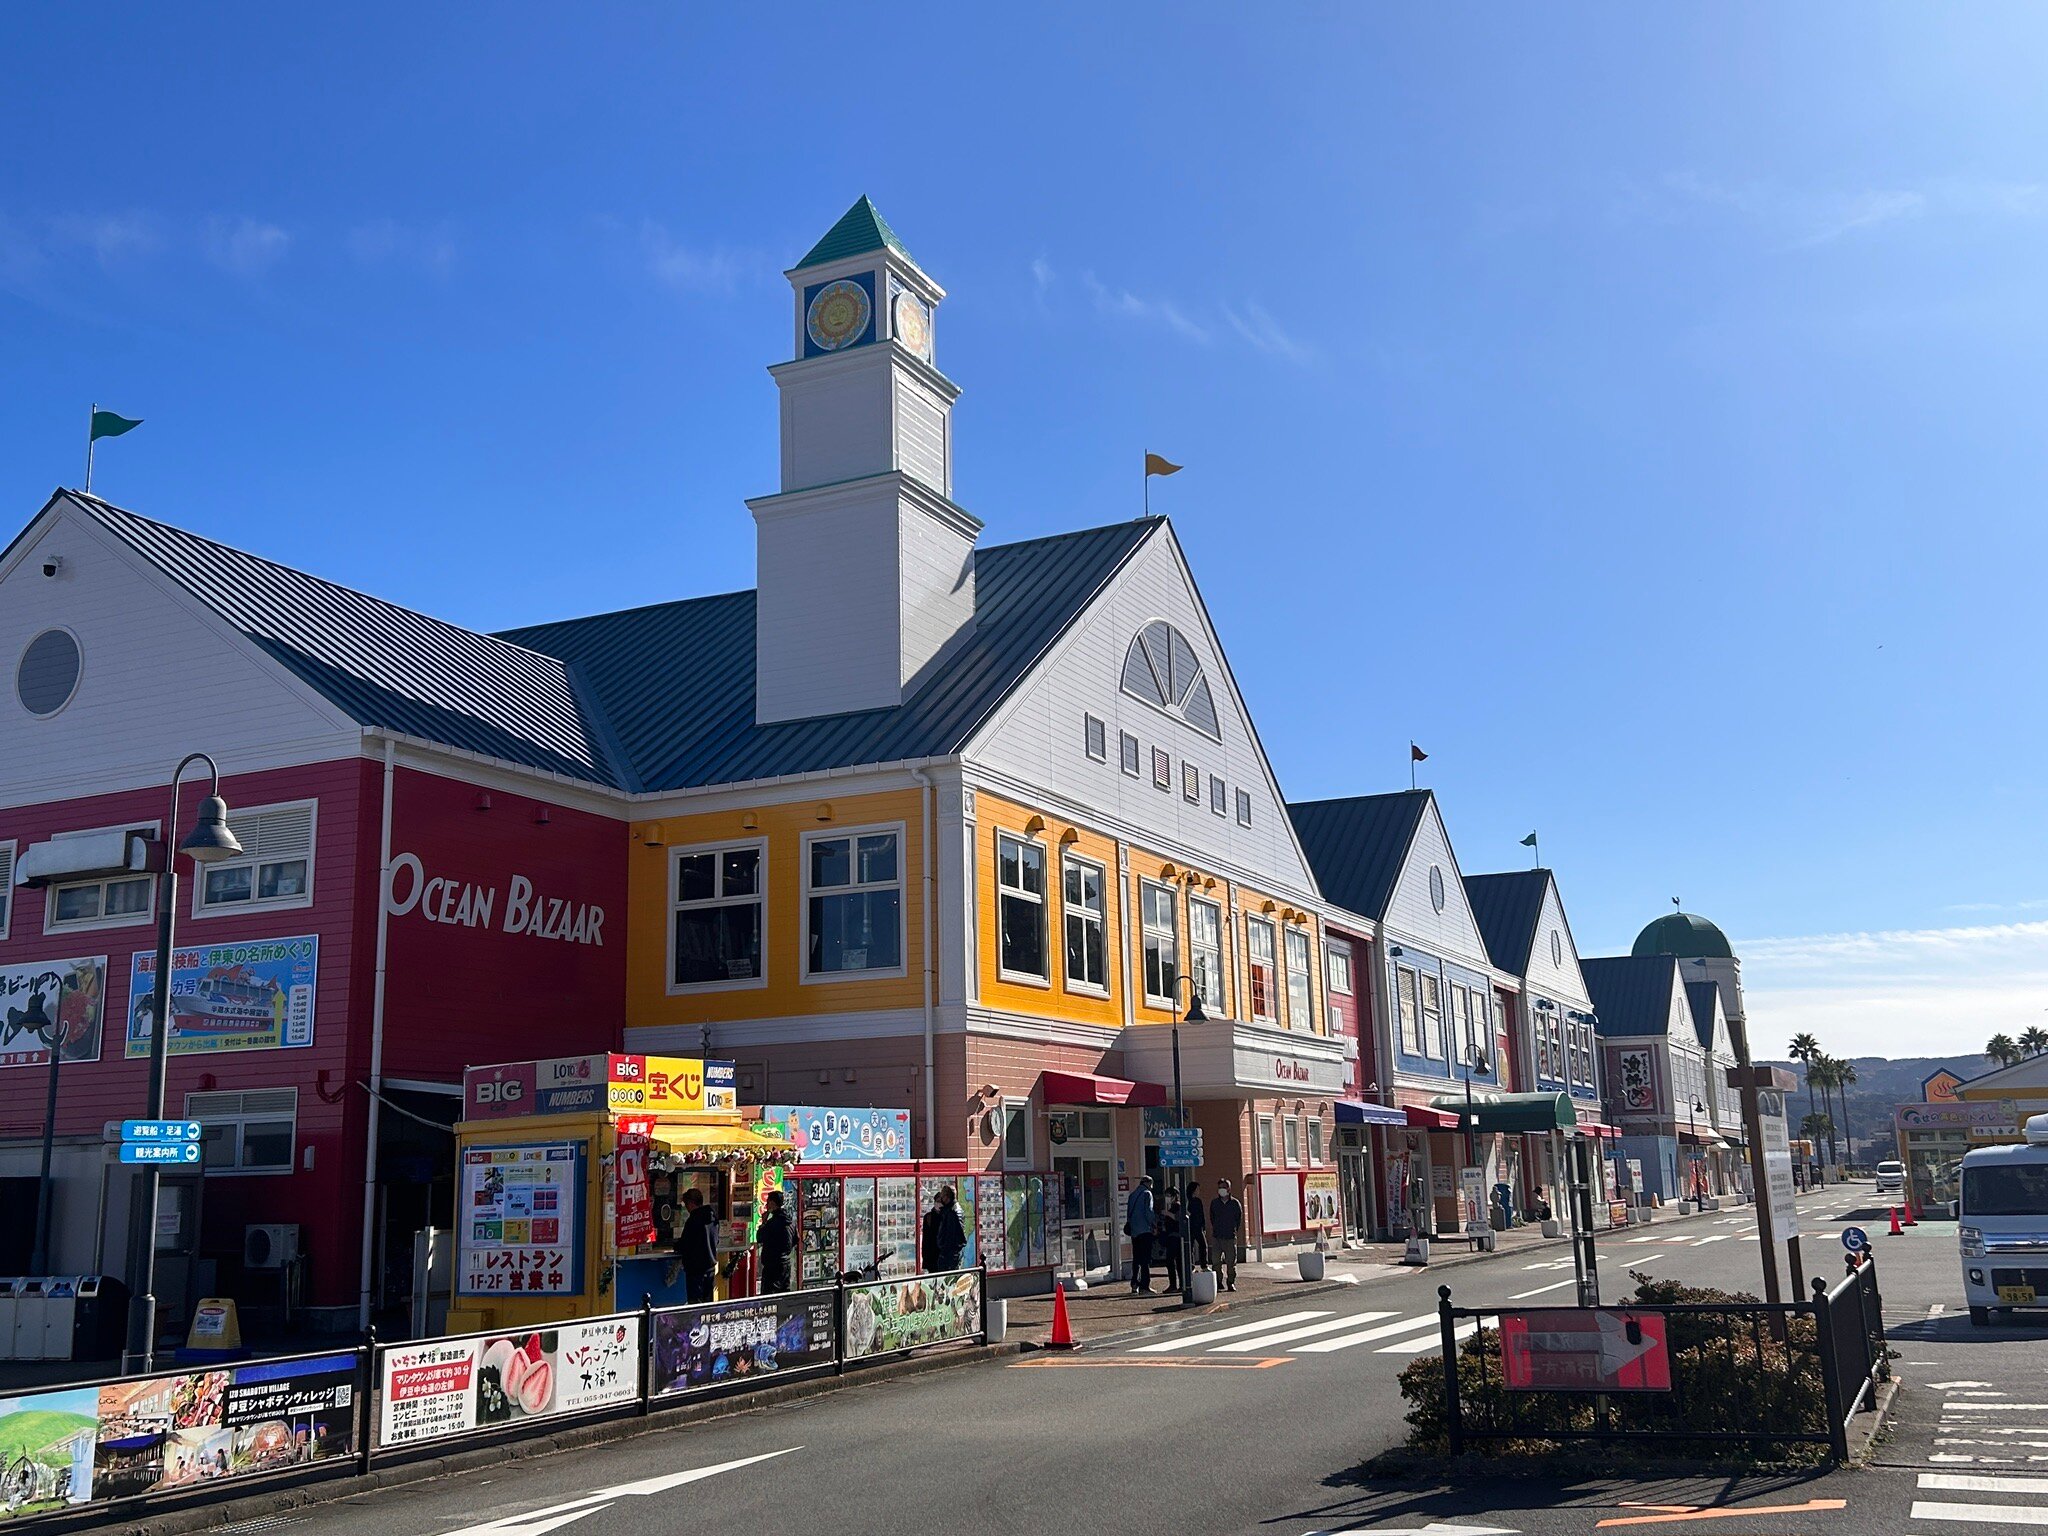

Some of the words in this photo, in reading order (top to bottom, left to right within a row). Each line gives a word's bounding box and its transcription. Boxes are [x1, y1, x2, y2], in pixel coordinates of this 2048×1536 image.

[503, 874, 605, 946] BAZAAR
[137, 941, 312, 972] 海底検船と伊東の名所めぐり
[554, 1064, 576, 1079] LOTO
[616, 1062, 640, 1077] BIG
[706, 1066, 734, 1080] NUMBERS
[476, 1080, 522, 1104] BIG
[648, 1072, 701, 1100] 宝くじ
[548, 1088, 594, 1107] NUMBERS
[133, 1125, 182, 1136] 遊覧船・足湯
[135, 1147, 179, 1158] 観光案内所
[812, 1182, 830, 1198] 360
[486, 1250, 564, 1269] レストラン
[509, 1269, 563, 1291] 営業中
[581, 1325, 615, 1338] 伊豆中央道
[229, 1389, 239, 1399] IZU
[269, 1382, 290, 1394] VILLAGE
[228, 1387, 335, 1414] 伊豆シャボテンヴィレッジ
[566, 1398, 582, 1406] TEL
